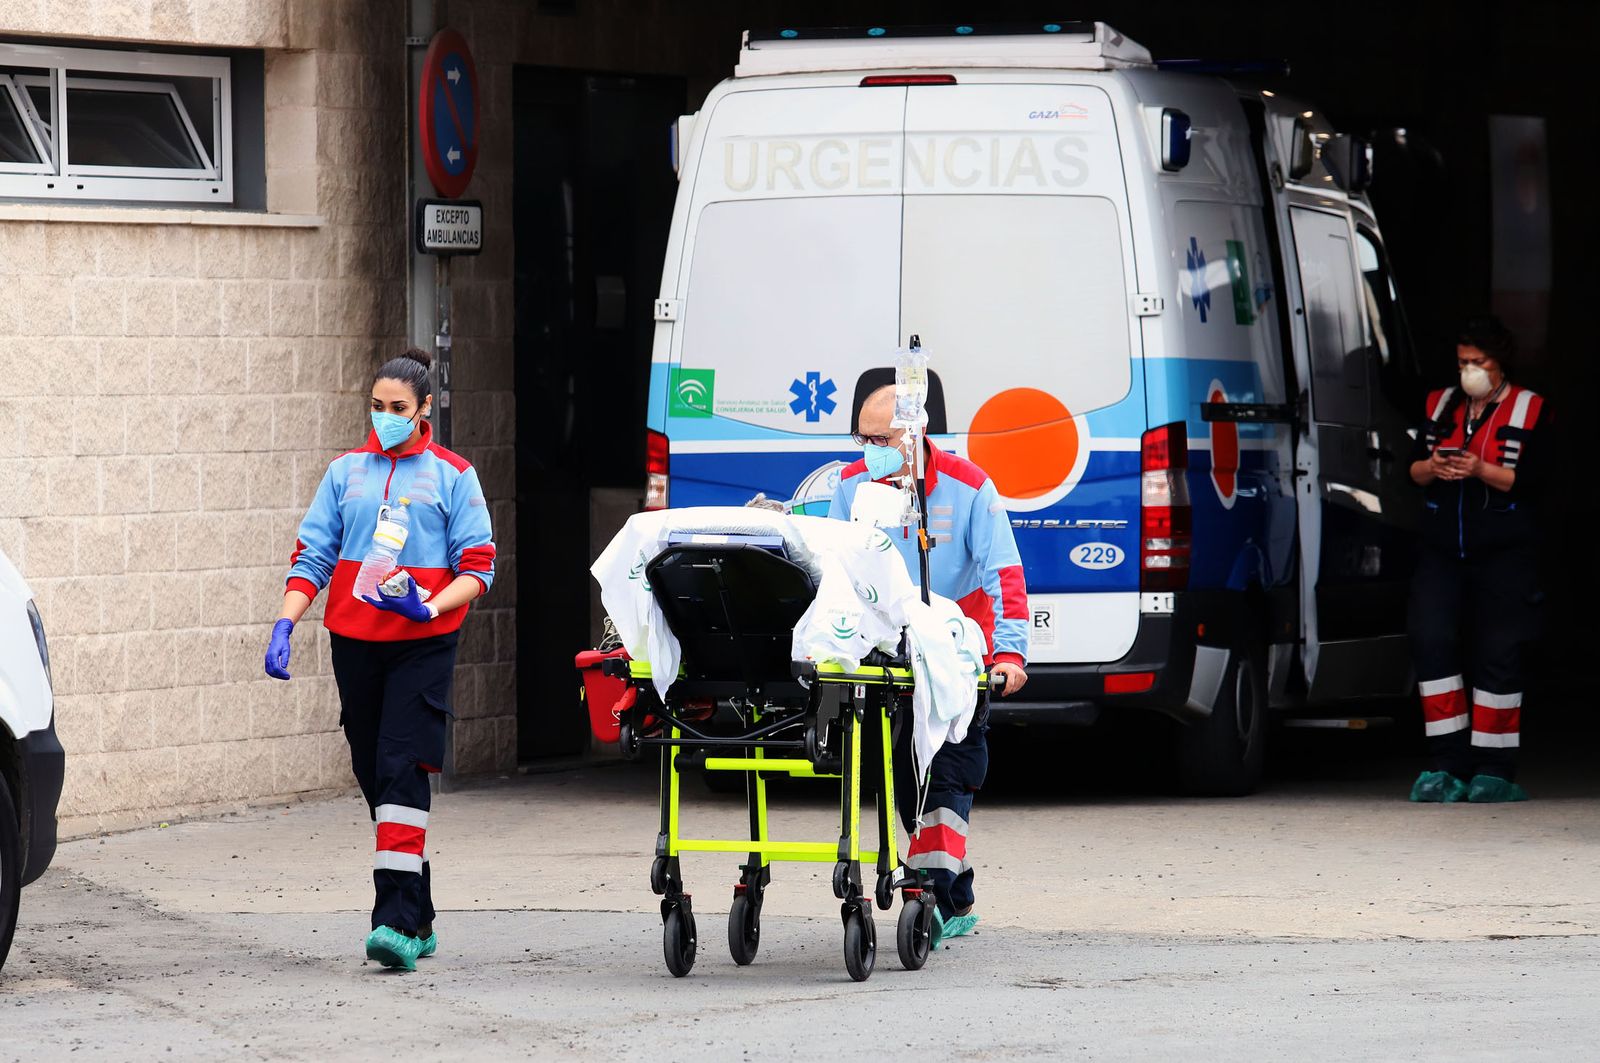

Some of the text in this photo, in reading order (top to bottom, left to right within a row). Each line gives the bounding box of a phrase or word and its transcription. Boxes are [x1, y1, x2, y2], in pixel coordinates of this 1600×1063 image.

[1028, 110, 1059, 119] GAZA
[723, 137, 1090, 192] URGENCIAS
[436, 209, 470, 225] EXCEPTO
[427, 229, 479, 245] AMBULANCIAS
[1043, 520, 1129, 528] BLUETEC
[1079, 546, 1117, 564] 229
